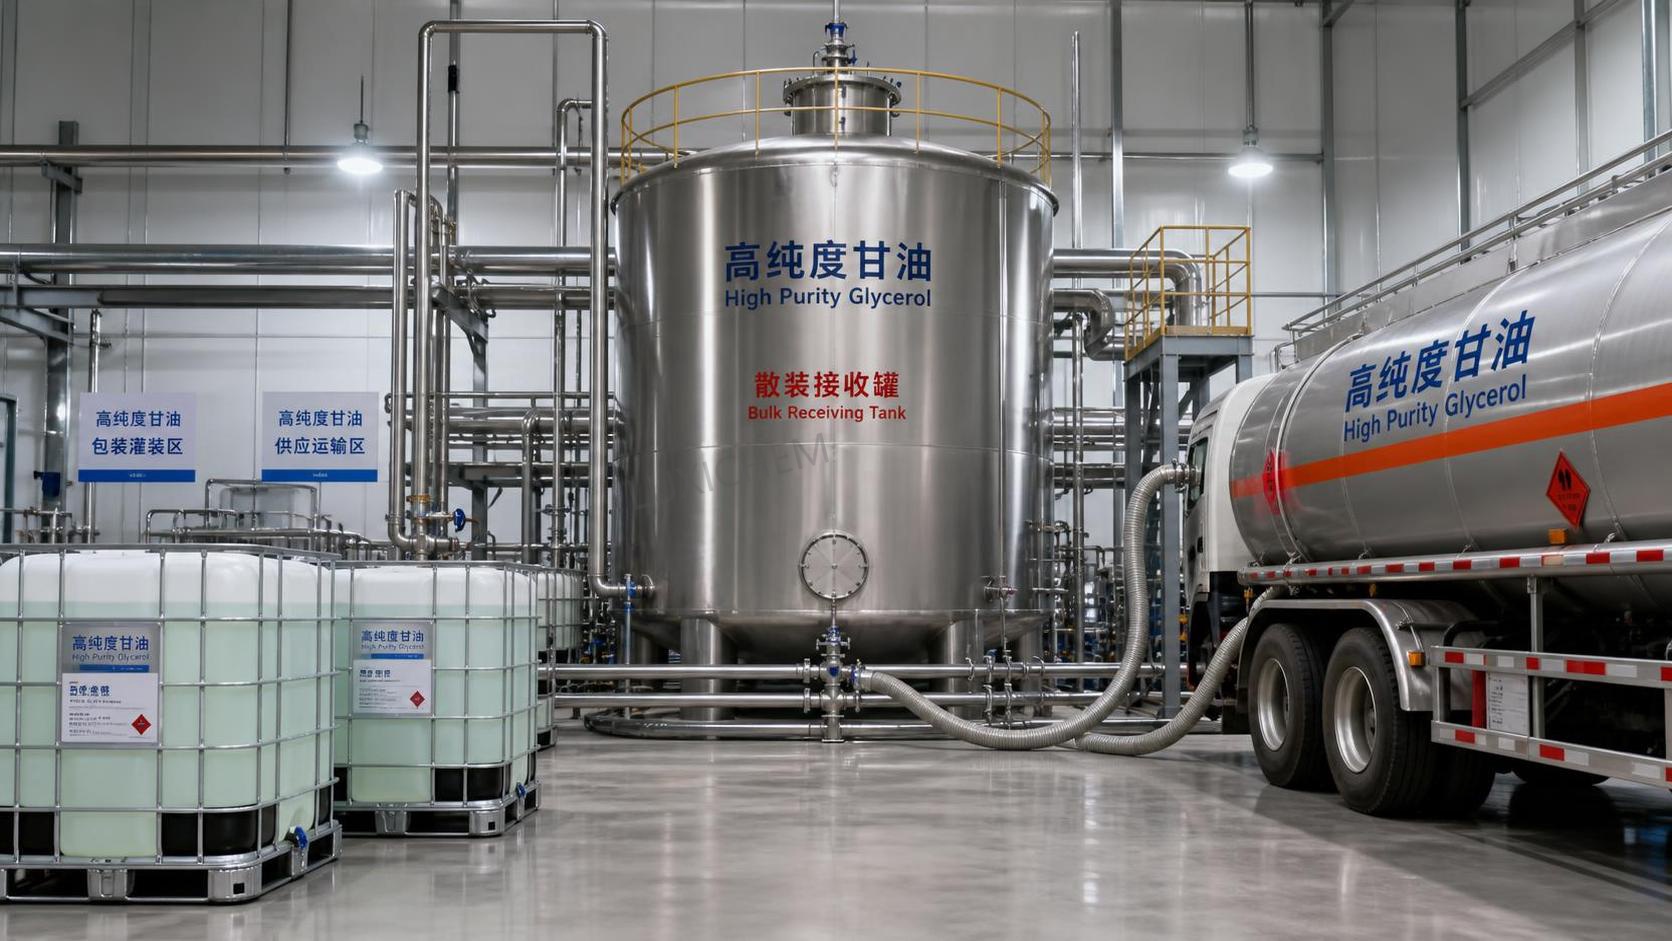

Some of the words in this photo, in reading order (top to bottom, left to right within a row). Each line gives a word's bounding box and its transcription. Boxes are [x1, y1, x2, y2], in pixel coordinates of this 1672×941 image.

[725, 240, 932, 281] 高纯度甘油
[725, 288, 772, 310] High
[780, 286, 841, 309] Purity
[848, 286, 932, 309] Glycerol
[1344, 310, 1536, 413] 高纯度甘油
[755, 371, 899, 399] 散装接收罐
[748, 405, 782, 420] Bulk
[788, 404, 864, 423] Receiving
[869, 405, 907, 420] Tank
[1343, 414, 1381, 443] High
[1387, 400, 1439, 432] Purity
[1445, 373, 1528, 419] Glycerol
[95, 409, 183, 429] 高纯度甘油
[277, 409, 364, 429] 高纯度甘油
[92, 436, 184, 457] 包装灌装区
[274, 436, 366, 457] 供应运输区
[72, 635, 149, 651] 高纯度甘油
